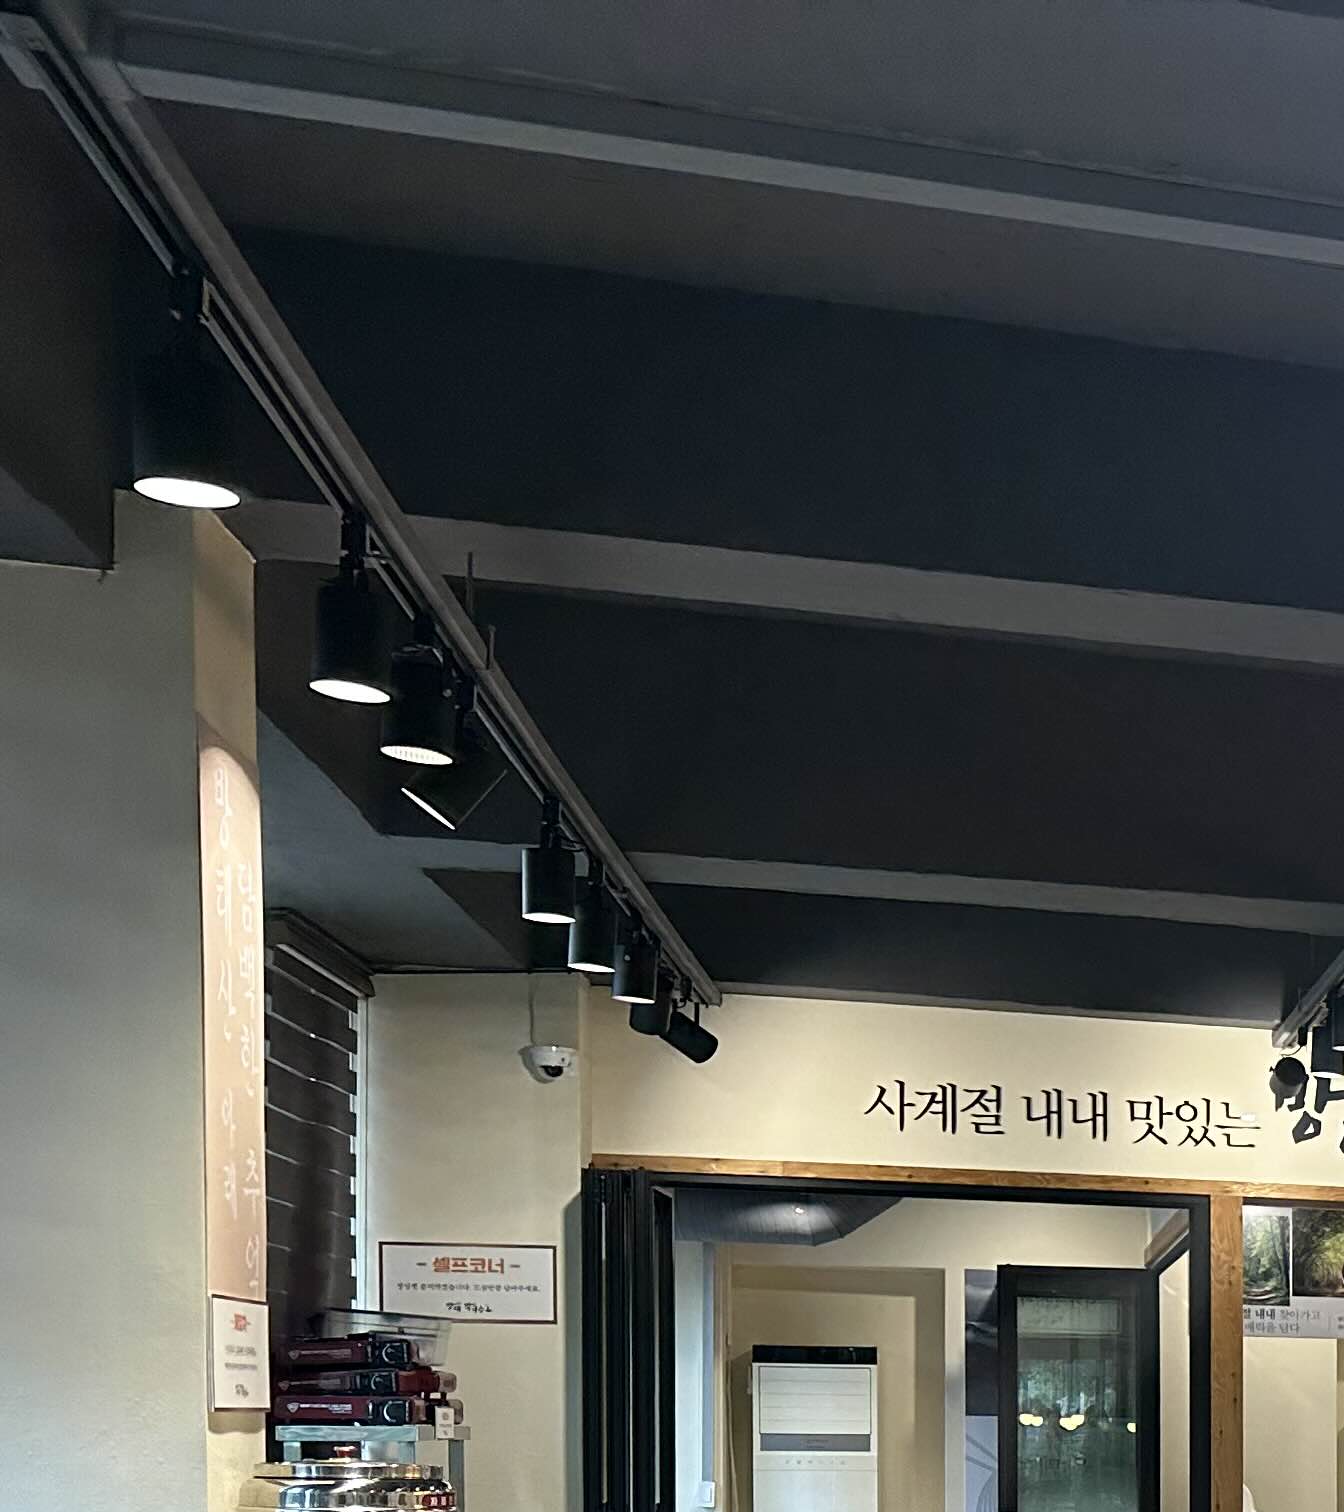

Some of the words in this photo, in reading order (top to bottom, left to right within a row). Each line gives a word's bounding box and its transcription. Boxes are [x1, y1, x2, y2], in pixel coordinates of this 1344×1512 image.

[863, 1080, 1005, 1136] 사계절
[1023, 1088, 1109, 1142] 내내
[1129, 1097, 1258, 1150] 맛있는
[432, 1256, 505, 1274] 셀프코너
